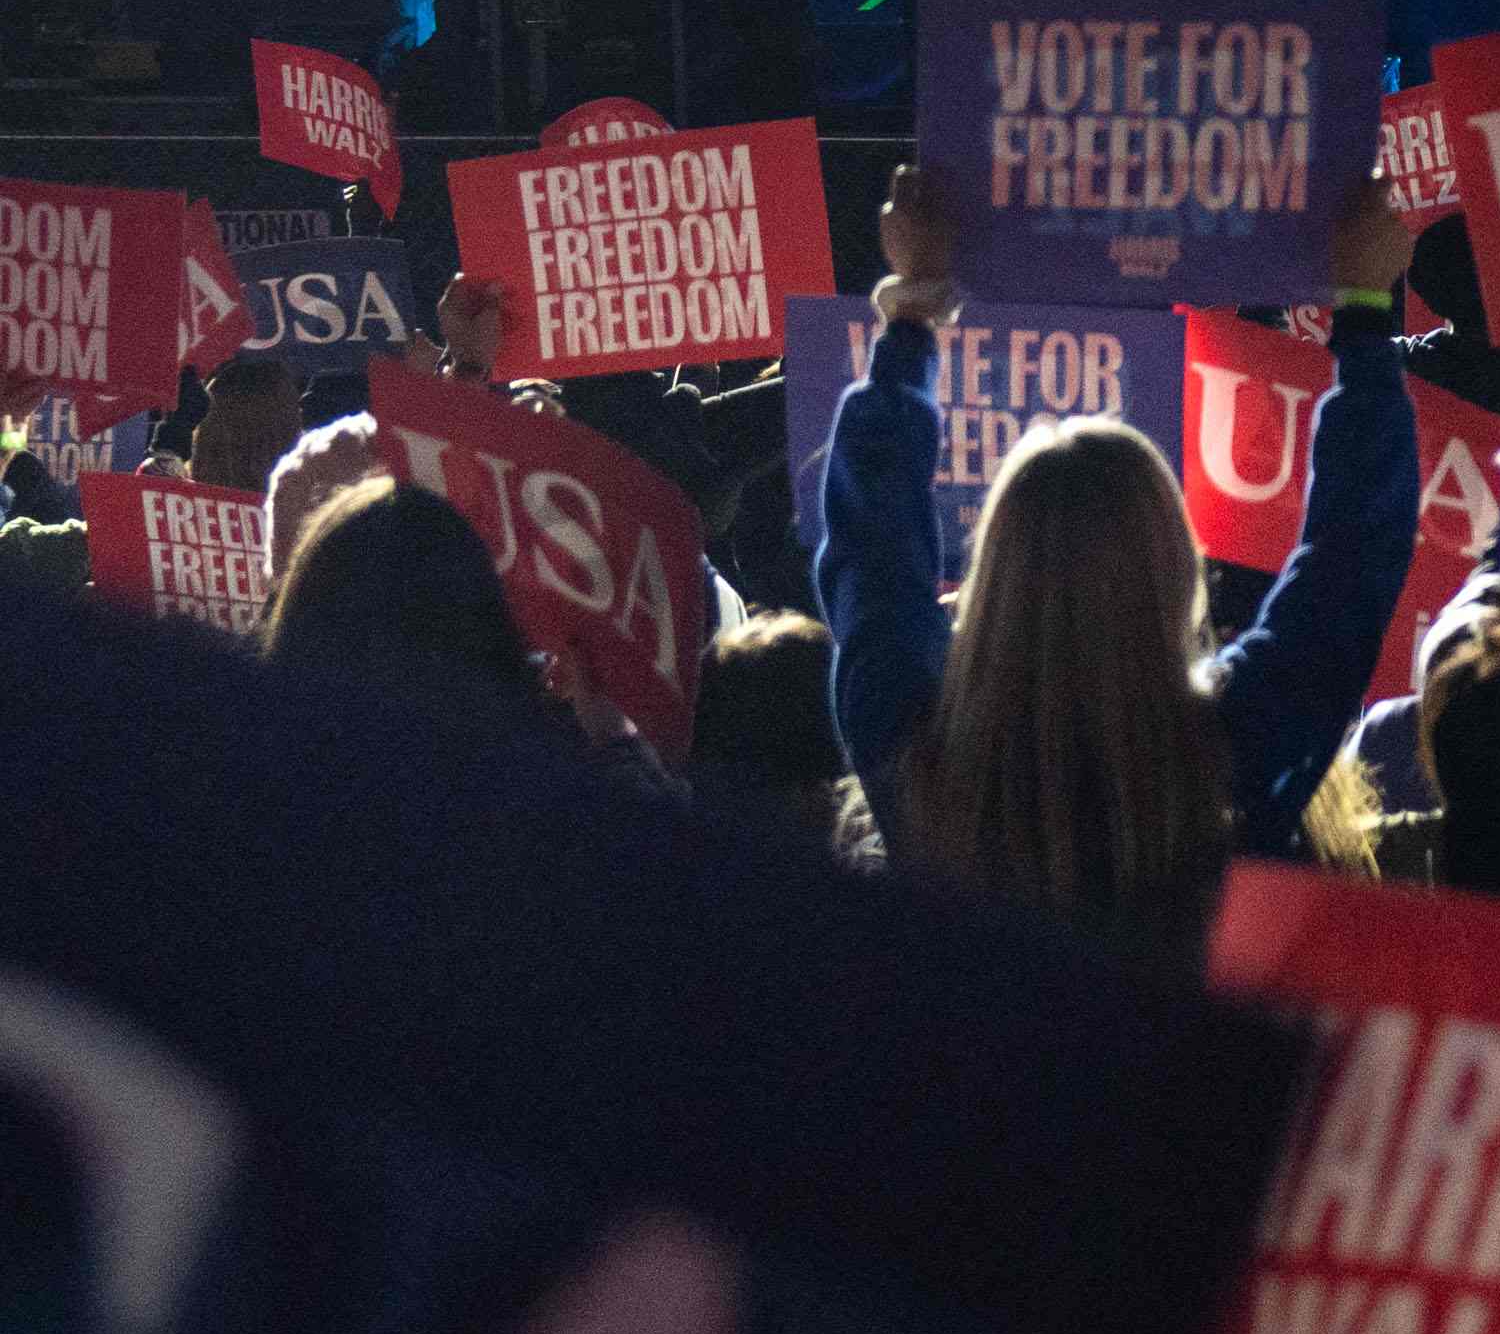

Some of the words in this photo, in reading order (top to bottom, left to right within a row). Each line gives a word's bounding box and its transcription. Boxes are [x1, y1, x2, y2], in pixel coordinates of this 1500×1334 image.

[992, 22, 1161, 116] VOTE
[1180, 22, 1313, 116] FOR
[992, 116, 1310, 211] FREEDOM
[1376, 111, 1450, 177] RRI
[519, 143, 753, 233] FREEDOM
[1390, 170, 1460, 212] ALZ
[527, 208, 765, 294] FREEDOM
[537, 272, 771, 361] FREEDOM
[1009, 329, 1122, 413] FOR
[143, 490, 267, 557] FREED
